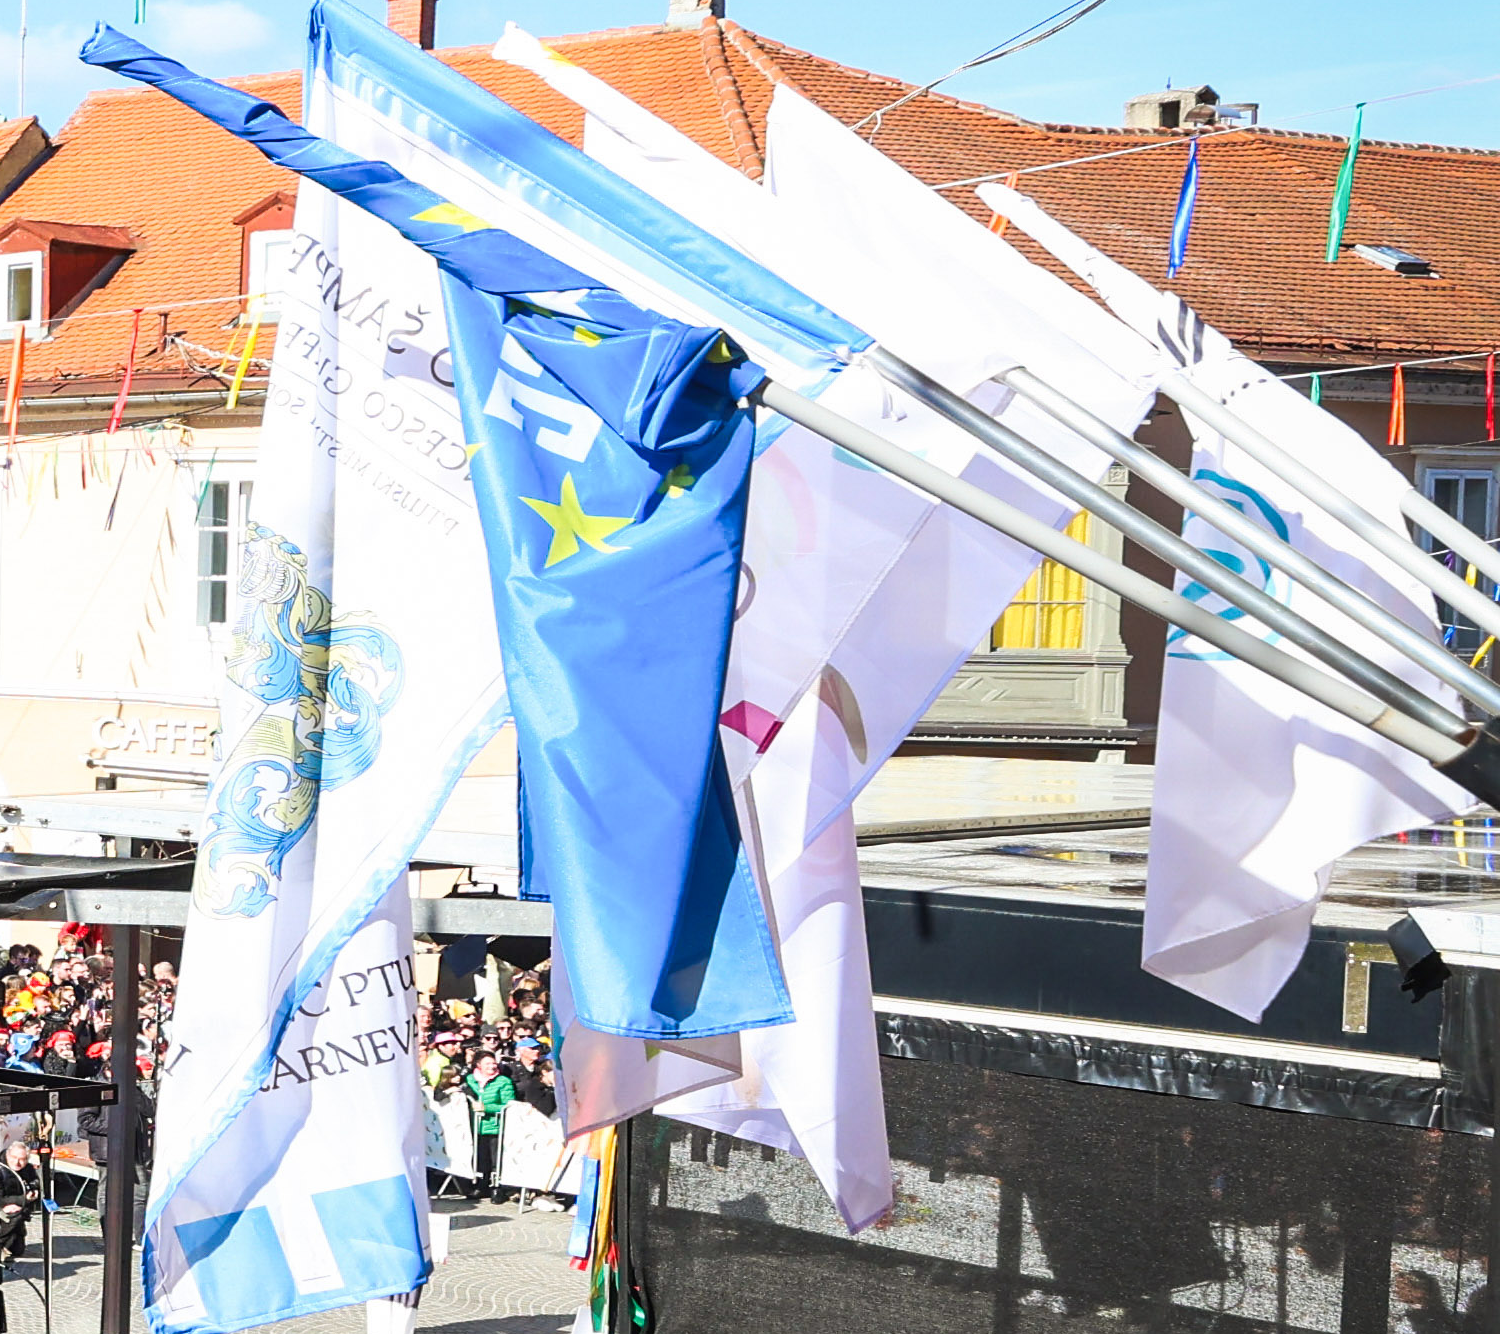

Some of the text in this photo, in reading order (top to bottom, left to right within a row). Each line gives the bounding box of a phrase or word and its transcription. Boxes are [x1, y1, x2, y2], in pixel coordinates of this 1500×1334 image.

[92, 715, 208, 756] CAFFE
[340, 955, 419, 1007] PTU
[258, 1014, 418, 1092] ARNEV
